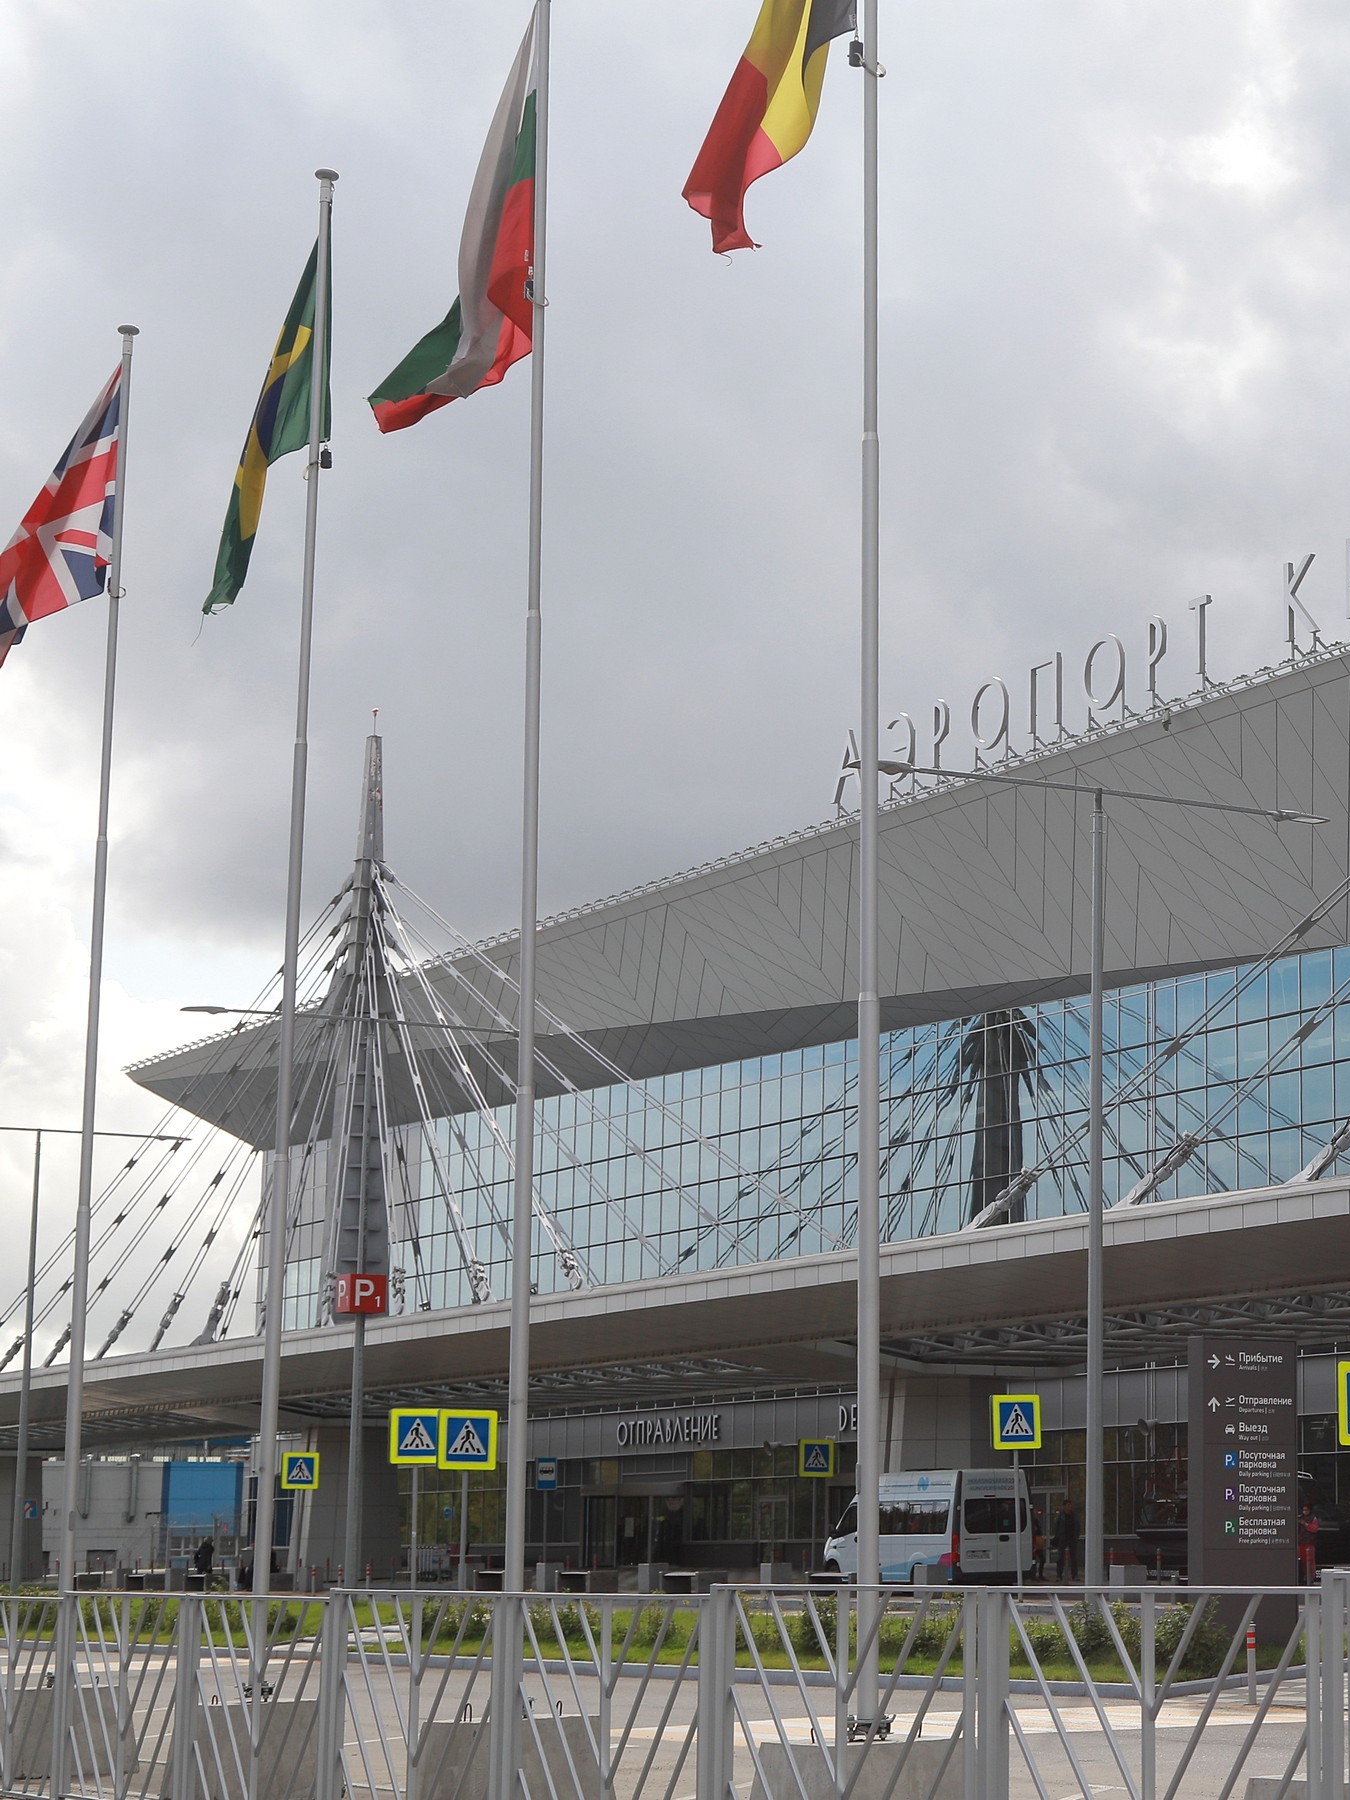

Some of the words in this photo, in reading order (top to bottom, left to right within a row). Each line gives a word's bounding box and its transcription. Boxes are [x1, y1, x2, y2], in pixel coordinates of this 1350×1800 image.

[834, 594, 1213, 805] АЭРОПОРТ
[354, 1278, 381, 1308] P1
[1238, 1352, 1283, 1364] Прибытие
[1238, 1394, 1293, 1407] Отправление
[1238, 1406, 1265, 1414] Departures
[616, 1414, 719, 1446] ОТПРАВЛЕНИЕ
[1238, 1421, 1268, 1434] Выезд
[1238, 1450, 1286, 1461] Посуточная
[1238, 1461, 1277, 1470] парковка
[1238, 1484, 1286, 1495] Посуточная
[1238, 1495, 1277, 1504] парковка
[1238, 1516, 1286, 1526] Бесплатная
[1238, 1528, 1277, 1537] парковка
